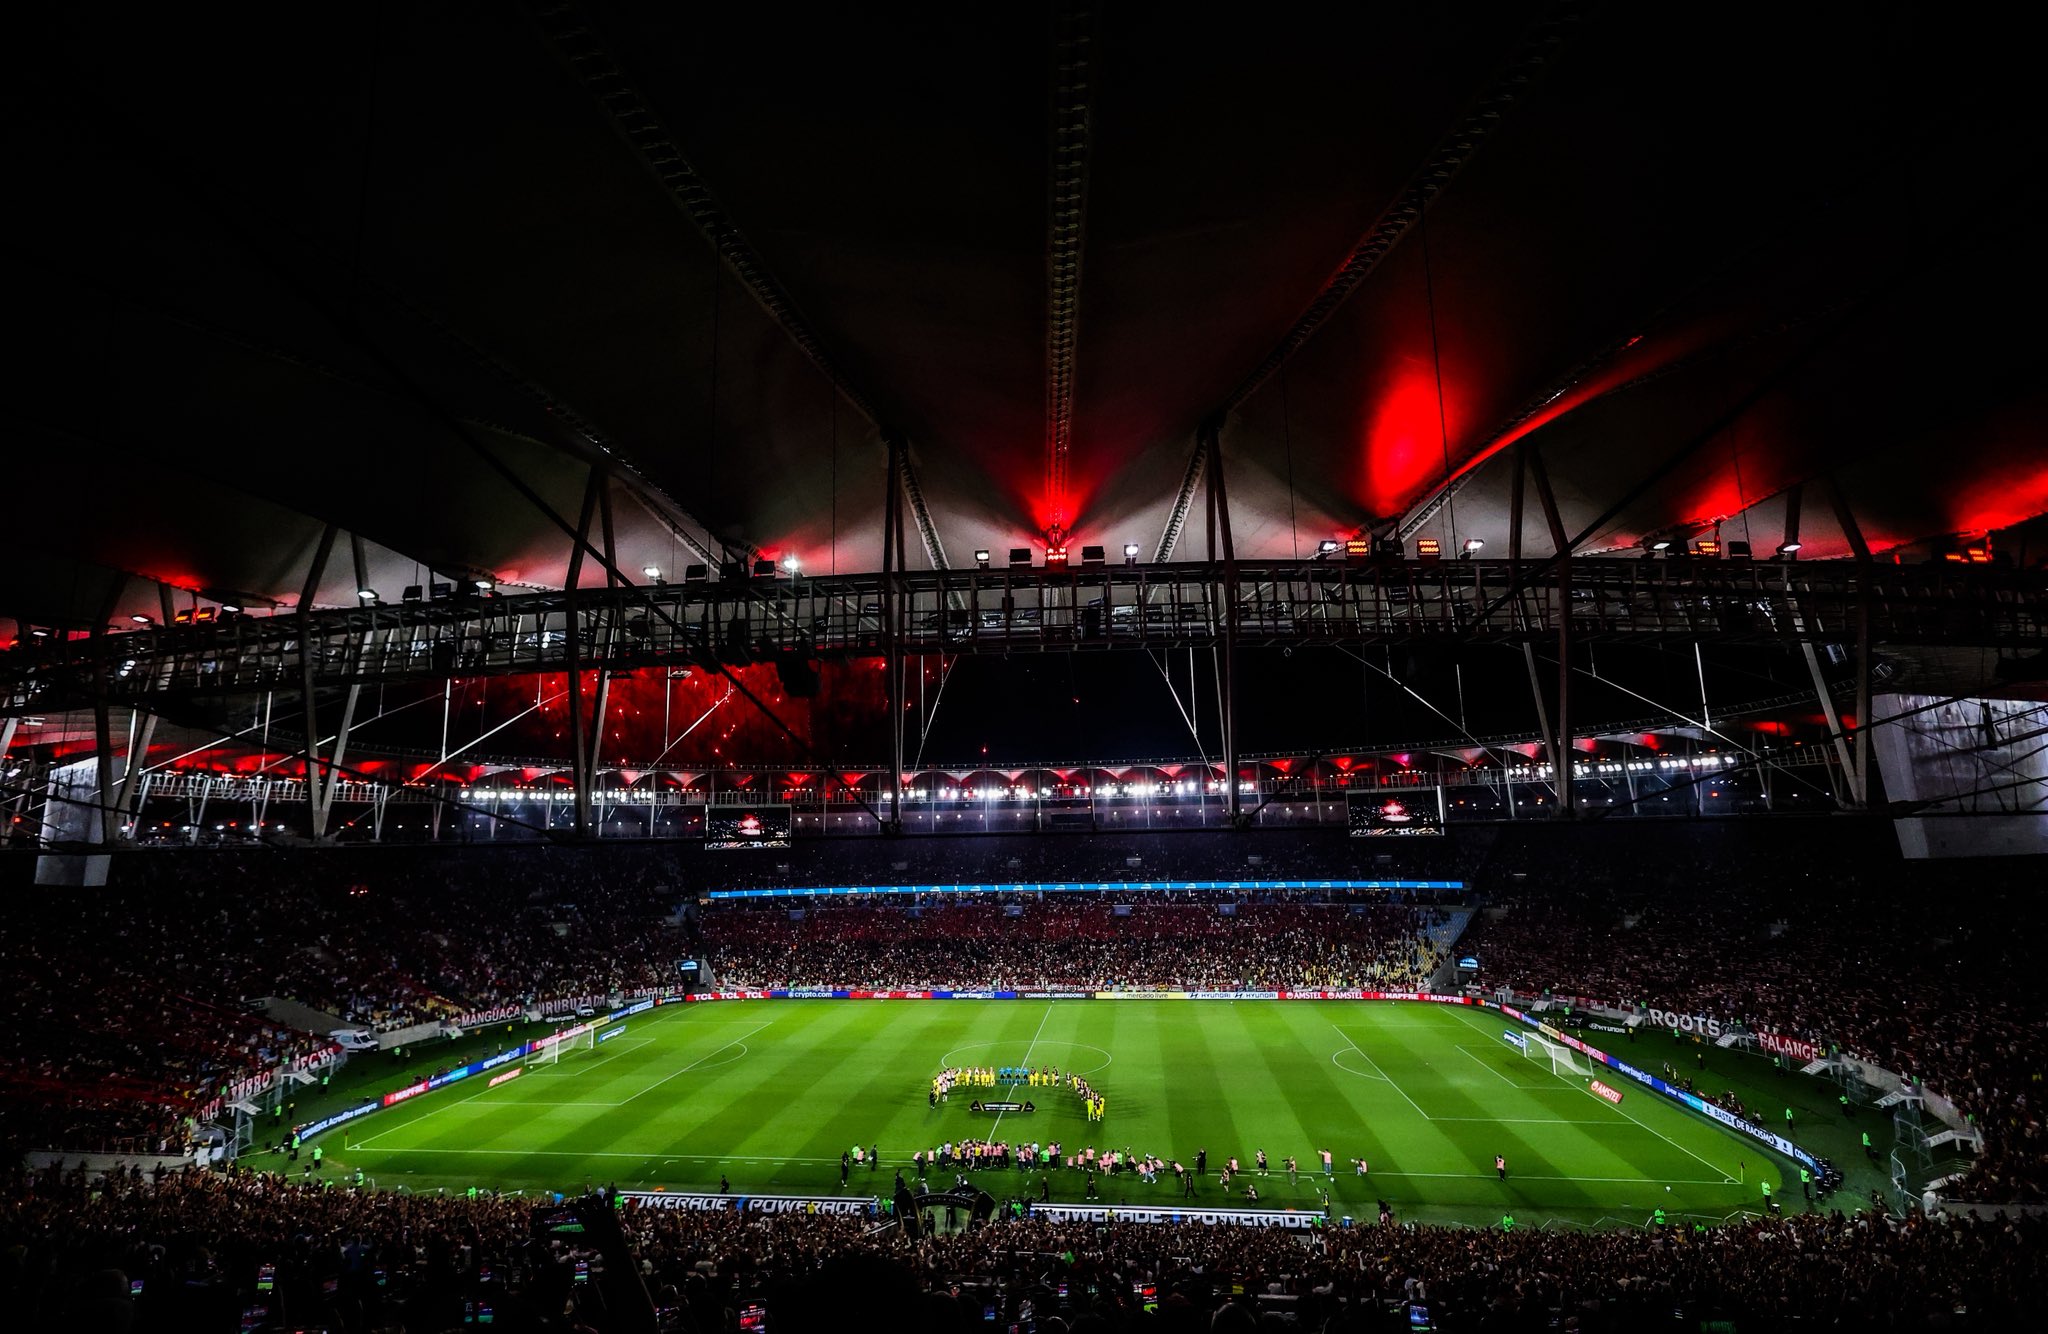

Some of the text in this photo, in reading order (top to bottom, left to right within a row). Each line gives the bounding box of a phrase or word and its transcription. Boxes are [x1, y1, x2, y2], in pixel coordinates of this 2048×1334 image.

[694, 993, 714, 1001] TCL
[720, 992, 740, 1000] TCL
[745, 991, 764, 999] TCL
[794, 991, 833, 999] crypto.com
[952, 992, 996, 1000] sportingbet
[1430, 994, 1464, 1004] MAPFRE
[1650, 1008, 1720, 1037] ROOTS
[1600, 1025, 1626, 1034] HYUNDAI
[1757, 1032, 1818, 1060] FALANGE
[1597, 1083, 1620, 1103] AMSTEL
[1714, 1109, 1774, 1145] BASTA DE RACISMO
